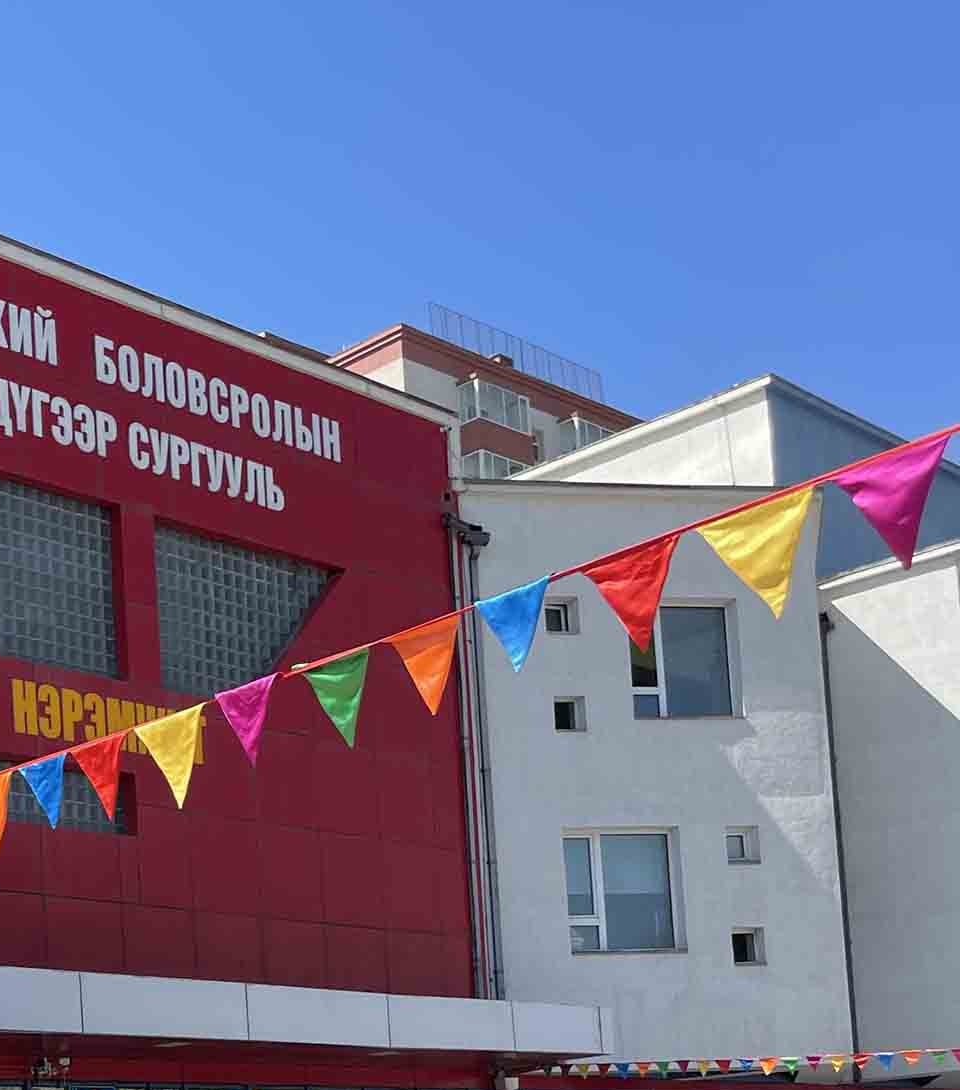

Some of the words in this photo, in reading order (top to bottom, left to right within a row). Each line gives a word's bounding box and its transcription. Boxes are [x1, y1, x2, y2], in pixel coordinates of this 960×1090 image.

[94, 335, 342, 463] БОЛОВСРОЛЫН
[128, 422, 285, 512] СУРГУУЛЬ
[12, 677, 207, 764] НЭРЭМ
